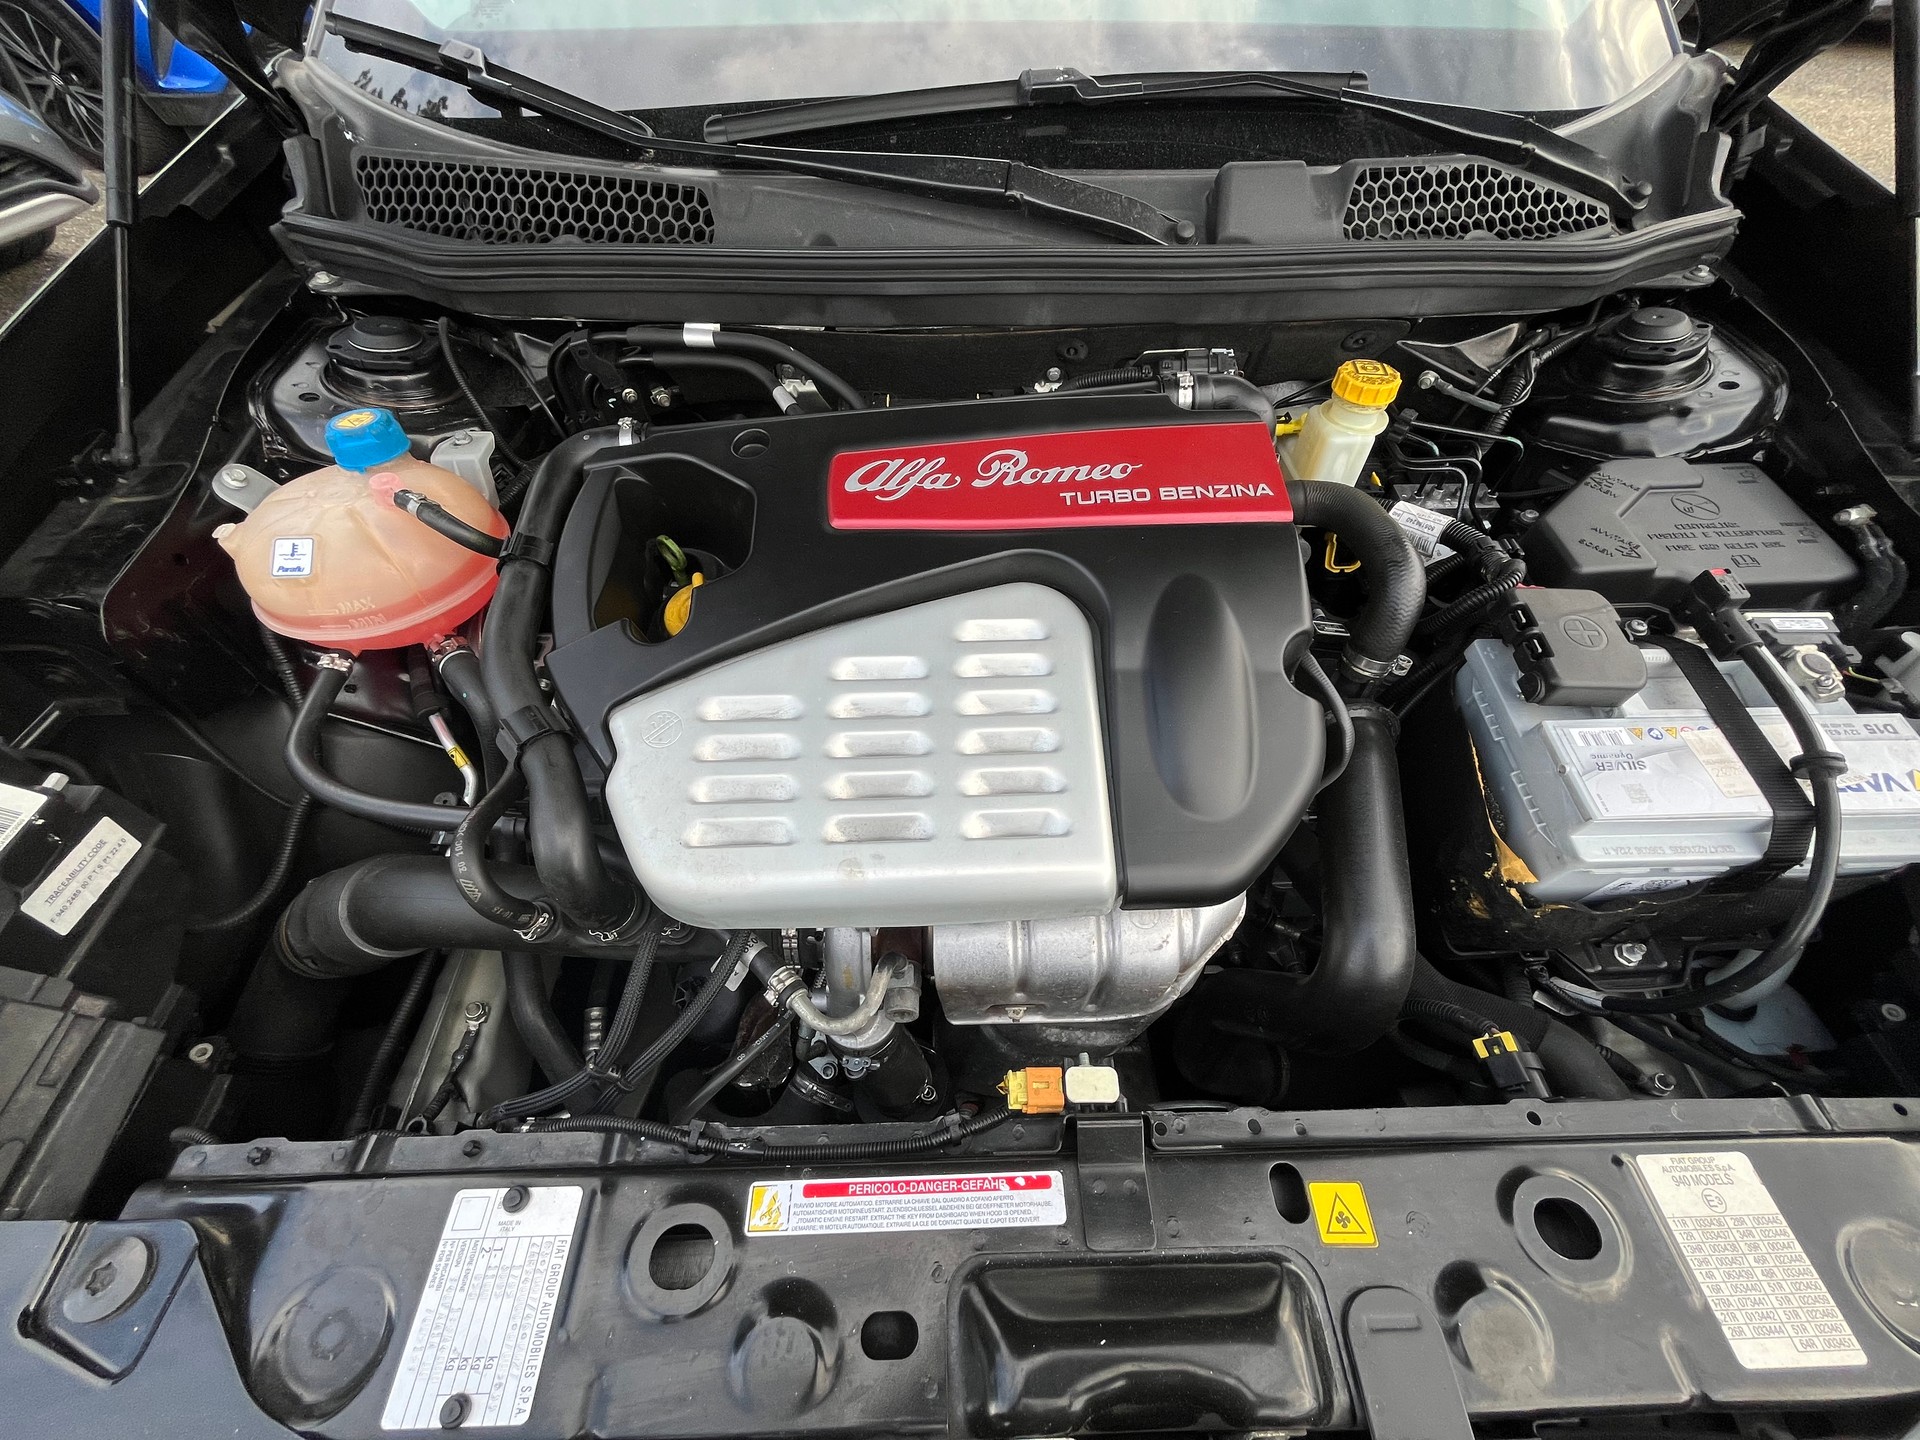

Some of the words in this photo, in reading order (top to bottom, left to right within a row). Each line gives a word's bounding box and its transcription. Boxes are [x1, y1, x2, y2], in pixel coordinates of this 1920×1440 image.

[844, 457, 961, 501] Alfa
[971, 449, 1143, 487] Romeo
[1059, 488, 1151, 506] TURBO
[1158, 483, 1275, 501] BENZINA
[276, 565, 306, 574] Paraflu
[337, 596, 376, 615] MAX
[348, 612, 388, 630] MIN
[1844, 728, 1862, 736] 12V
[1863, 723, 1900, 735] D15
[1595, 760, 1648, 772] SILVER
[44, 856, 90, 906] TRACEABILITY
[87, 838, 108, 859] CODE
[1669, 1156, 1687, 1165] FIAT
[1688, 1156, 1716, 1165] GROUP
[1661, 1164, 1716, 1174] AUTOMOBILES
[1671, 1174, 1692, 1187] 940
[1689, 1173, 1735, 1187] MODELS
[454, 1239, 468, 1268] VERSION
[552, 1239, 568, 1260] FIAT
[428, 1263, 443, 1290] SPARES
[434, 1264, 450, 1293] RICAMBI
[544, 1262, 562, 1299] GROUP
[524, 1301, 552, 1379] AUTOMOBILES
[444, 1357, 460, 1372] kg
[457, 1356, 472, 1371] kg
[470, 1356, 486, 1371] kg
[483, 1355, 499, 1370] kg
